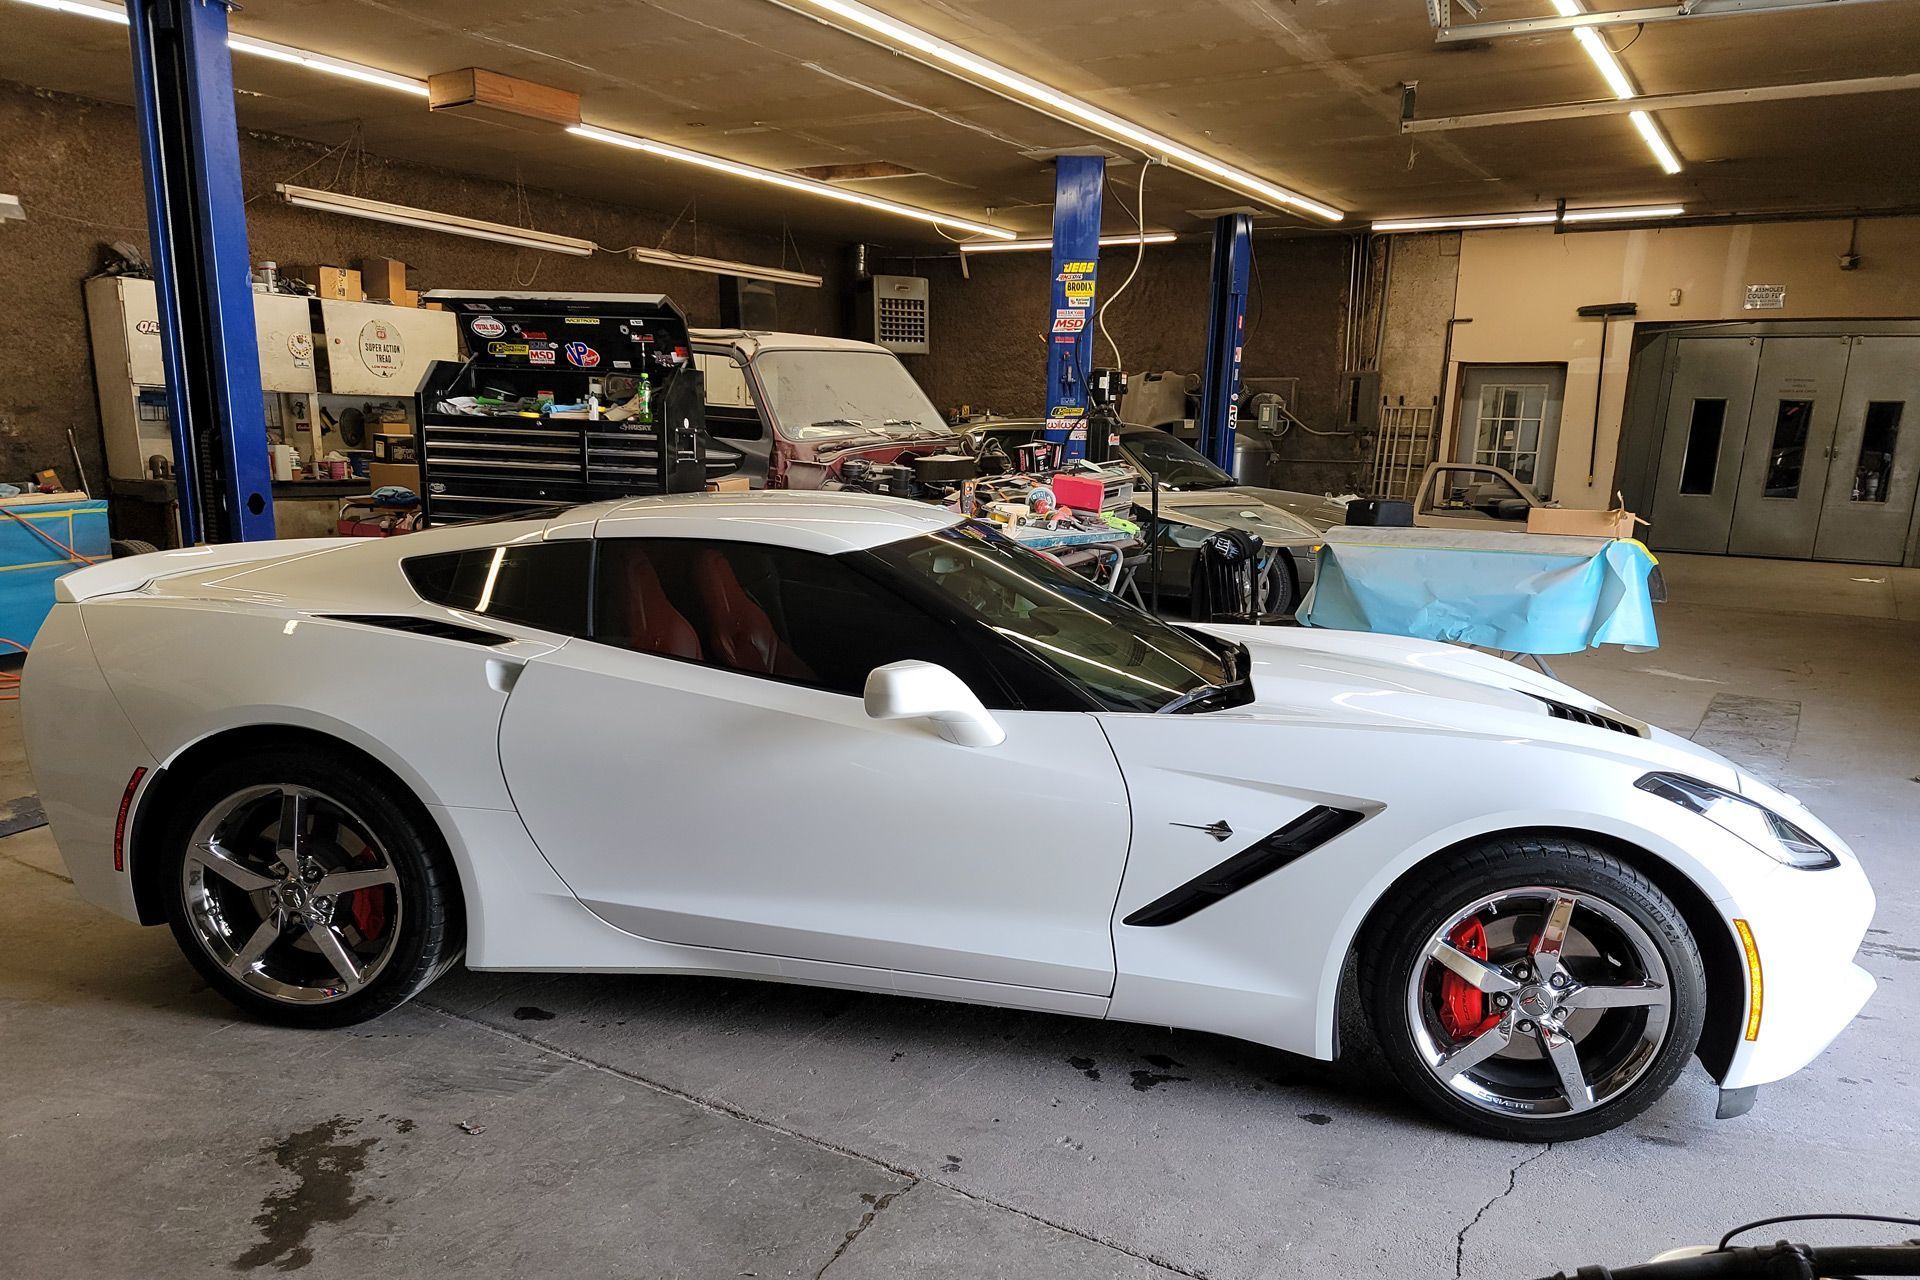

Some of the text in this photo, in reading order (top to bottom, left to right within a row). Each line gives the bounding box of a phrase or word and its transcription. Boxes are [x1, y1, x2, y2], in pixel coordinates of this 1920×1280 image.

[1066, 262, 1095, 273] JEGS
[1067, 282, 1093, 291] BRODIX
[474, 323, 490, 331] TOTAL
[1055, 319, 1084, 328] MSD
[365, 343, 400, 353] SUPER ACTION
[376, 354, 391, 363] TREAD
[530, 351, 554, 360] MSD
[565, 342, 588, 367] VP
